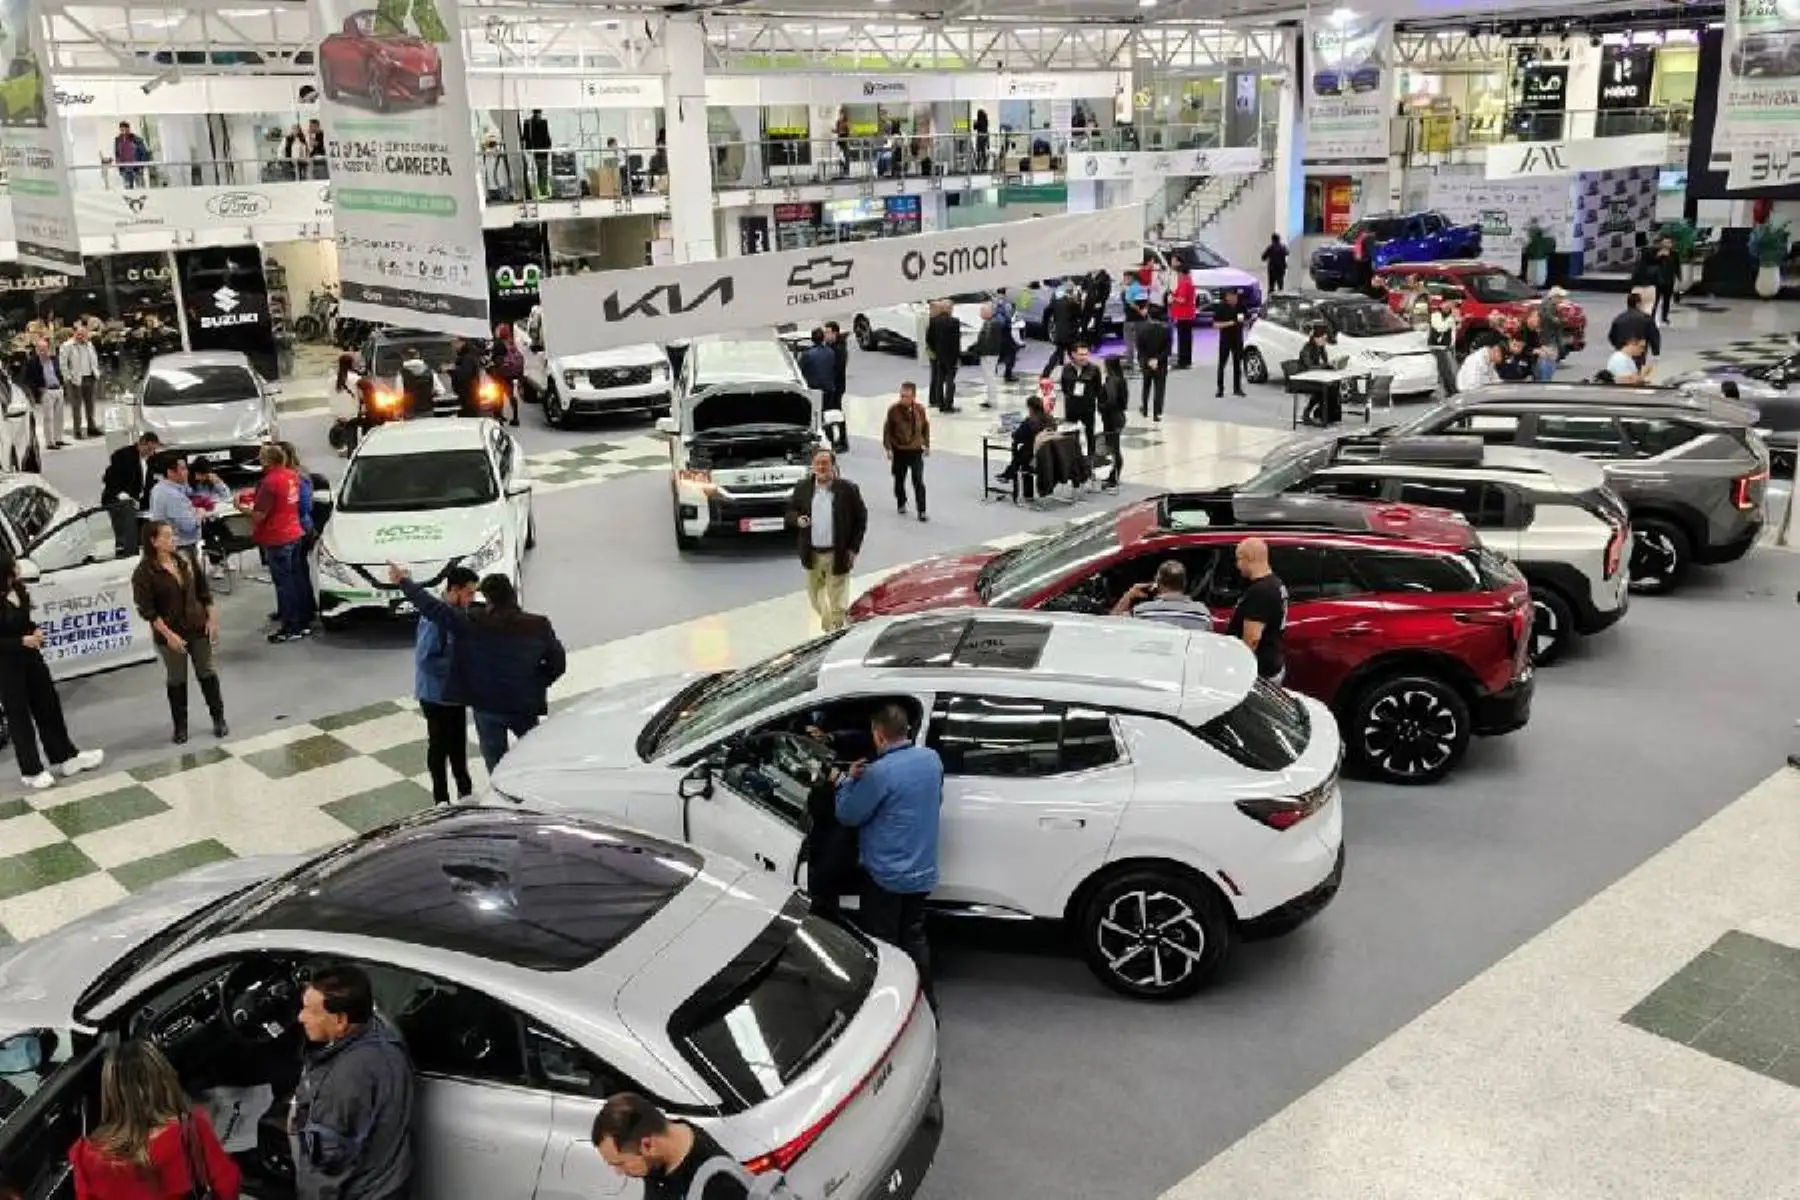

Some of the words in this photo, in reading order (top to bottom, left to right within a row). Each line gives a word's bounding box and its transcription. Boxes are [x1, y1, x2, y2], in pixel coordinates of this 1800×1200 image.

[786, 287, 855, 306] CHEVROLET
[932, 237, 1009, 277] smart
[200, 312, 259, 329] SUZUKI
[40, 621, 130, 649] EXPERIENCE
